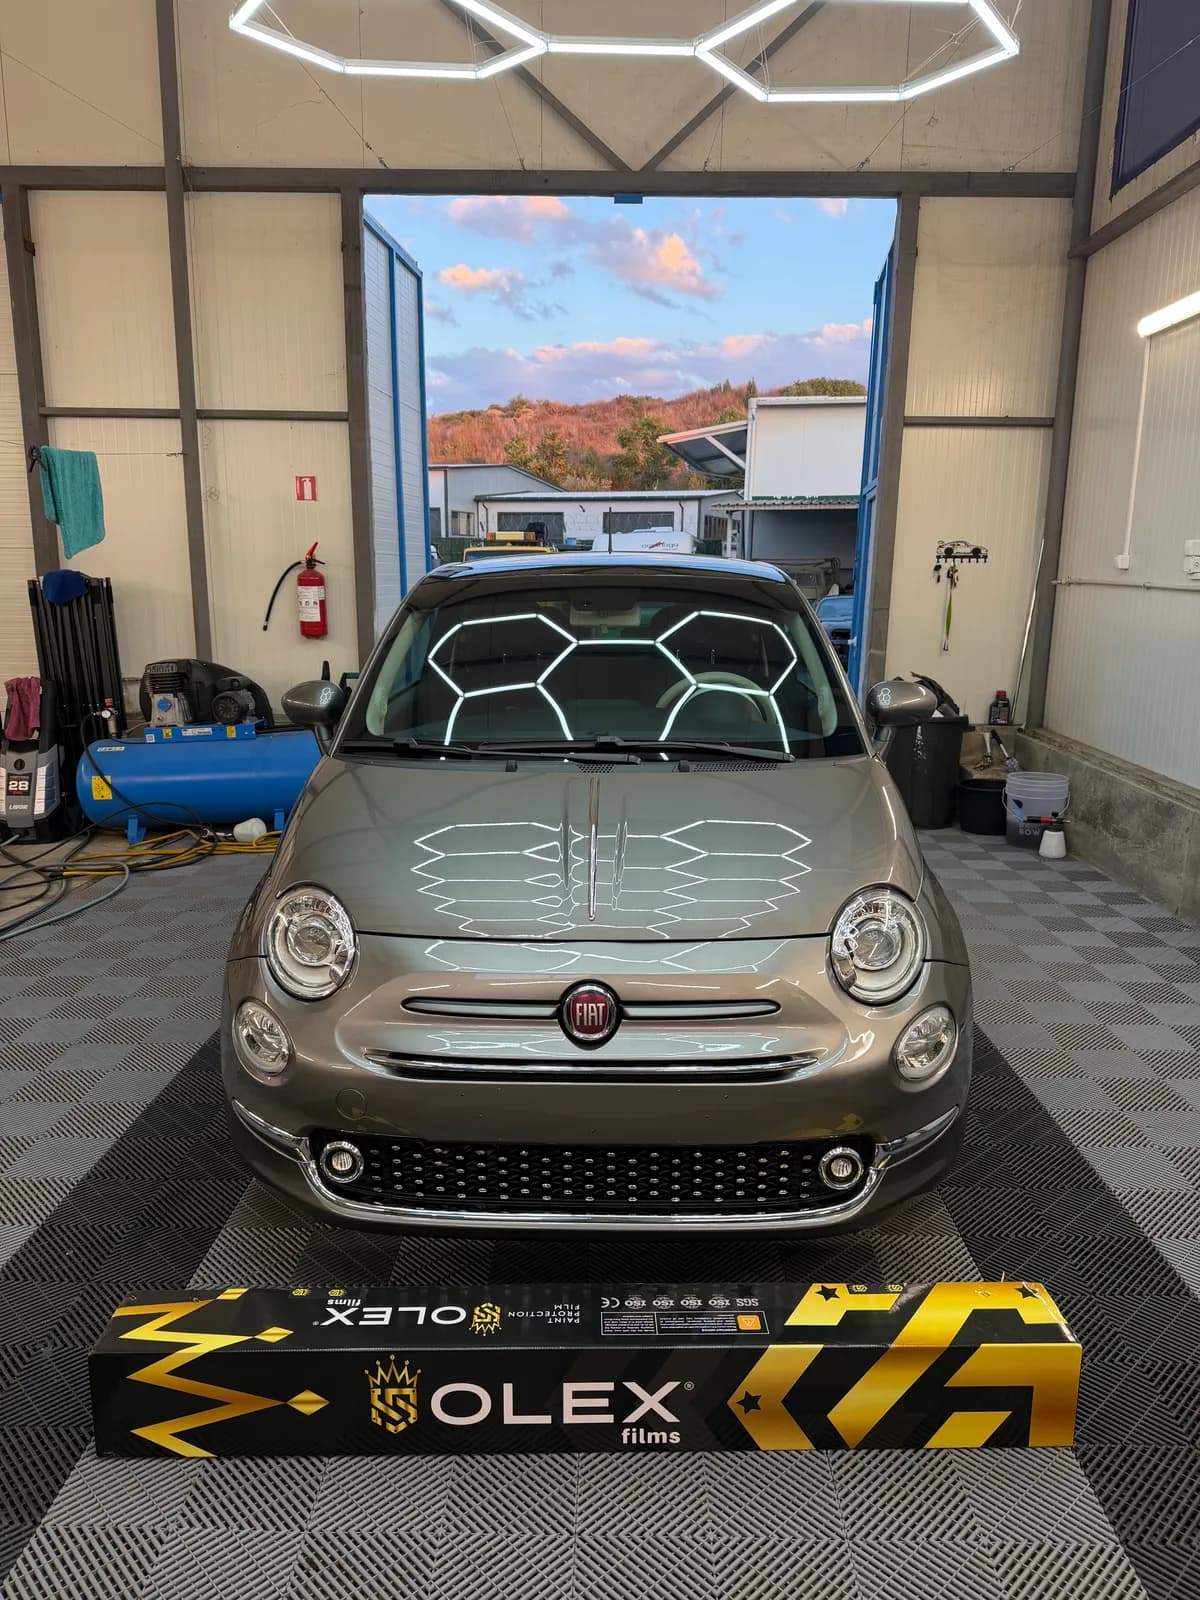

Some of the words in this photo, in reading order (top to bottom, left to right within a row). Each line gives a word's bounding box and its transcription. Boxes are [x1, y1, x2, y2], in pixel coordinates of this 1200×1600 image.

[9, 780, 29, 791] 28
[575, 1003, 606, 1026] FIAT
[327, 1299, 361, 1307] films
[736, 1298, 760, 1307] SGS
[508, 1310, 580, 1318] PROTECTION
[621, 1428, 681, 1444] films
